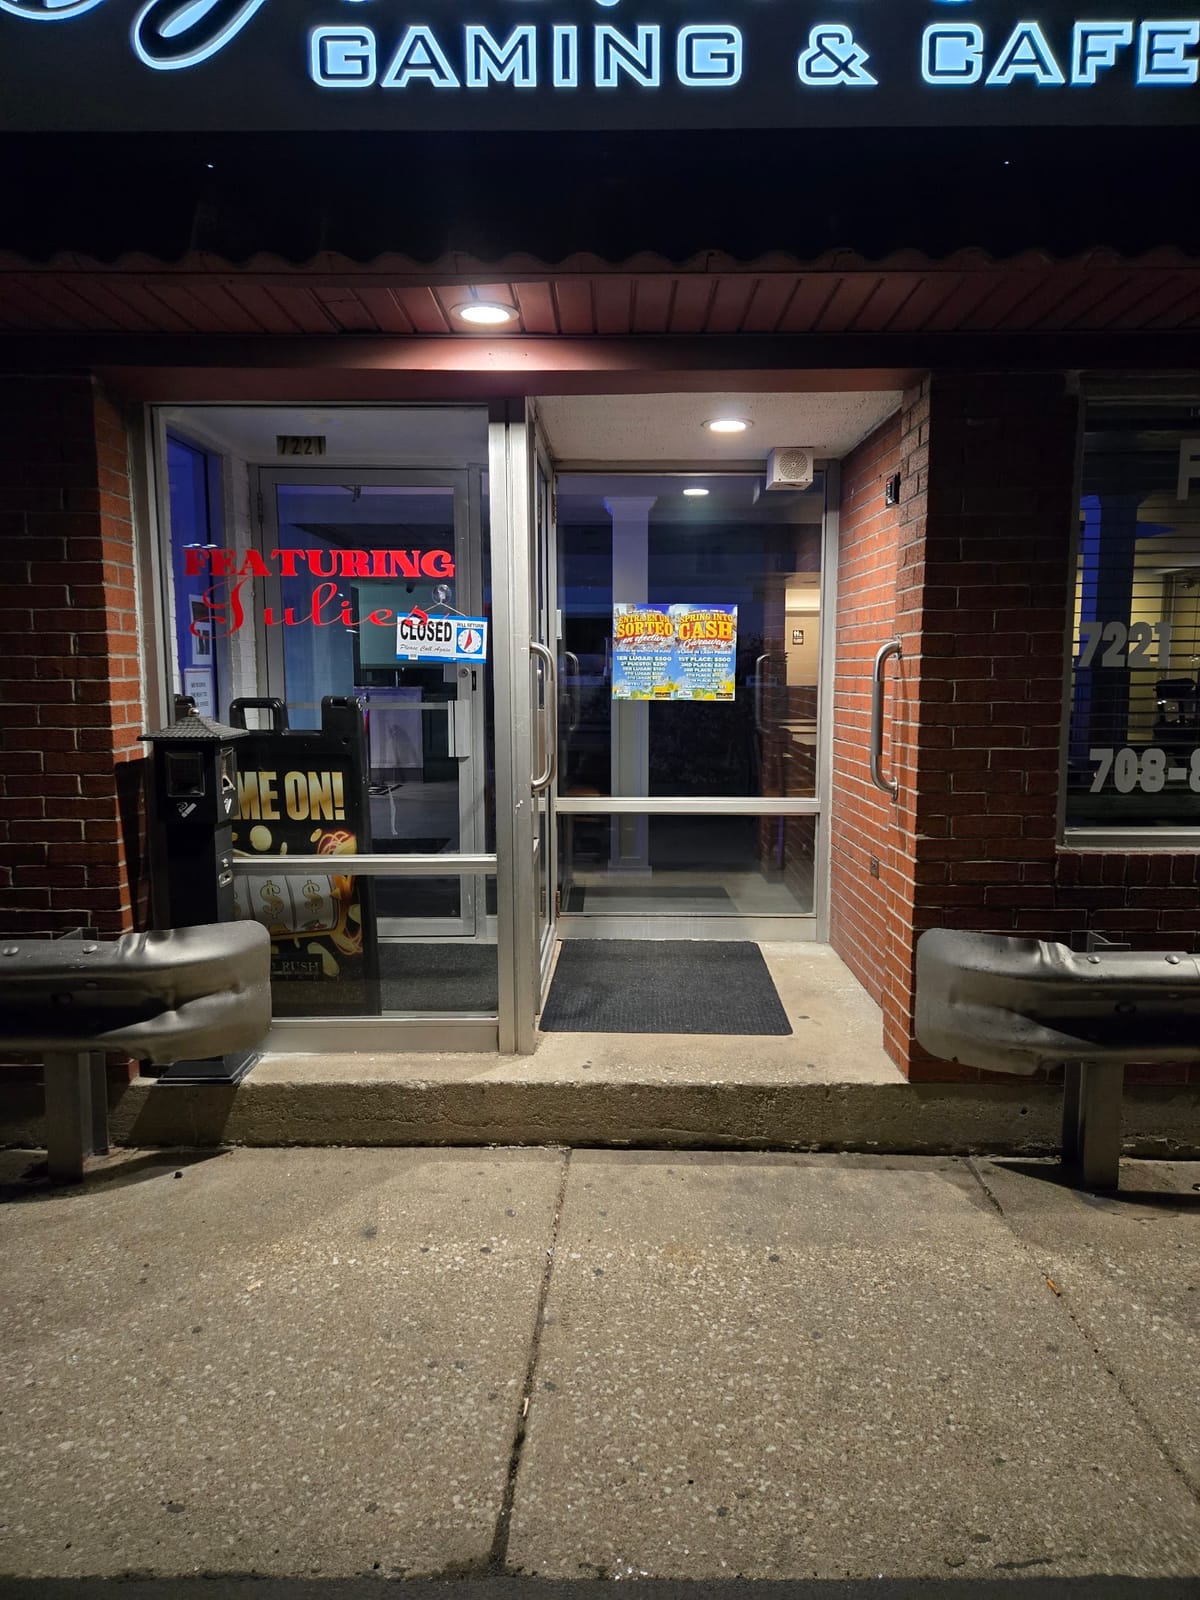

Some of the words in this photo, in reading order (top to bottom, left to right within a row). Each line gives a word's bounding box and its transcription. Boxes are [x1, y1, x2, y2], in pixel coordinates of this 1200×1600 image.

[309, 24, 743, 89] GAMING
[797, 22, 879, 87] &
[921, 19, 1200, 87] CAFE
[279, 437, 323, 455] 7221
[182, 548, 456, 578] FEATURING
[679, 613, 711, 623] SPRING
[713, 613, 733, 622] INTO
[400, 619, 452, 642] CLOSED
[617, 622, 673, 638] SORTEO
[678, 620, 733, 640] CASH
[399, 643, 418, 651] Please
[419, 644, 432, 652] Call
[1078, 621, 1172, 669] 7221
[231, 770, 281, 821] ME
[284, 770, 346, 821] ON!
[281, 960, 319, 972] RUSH
